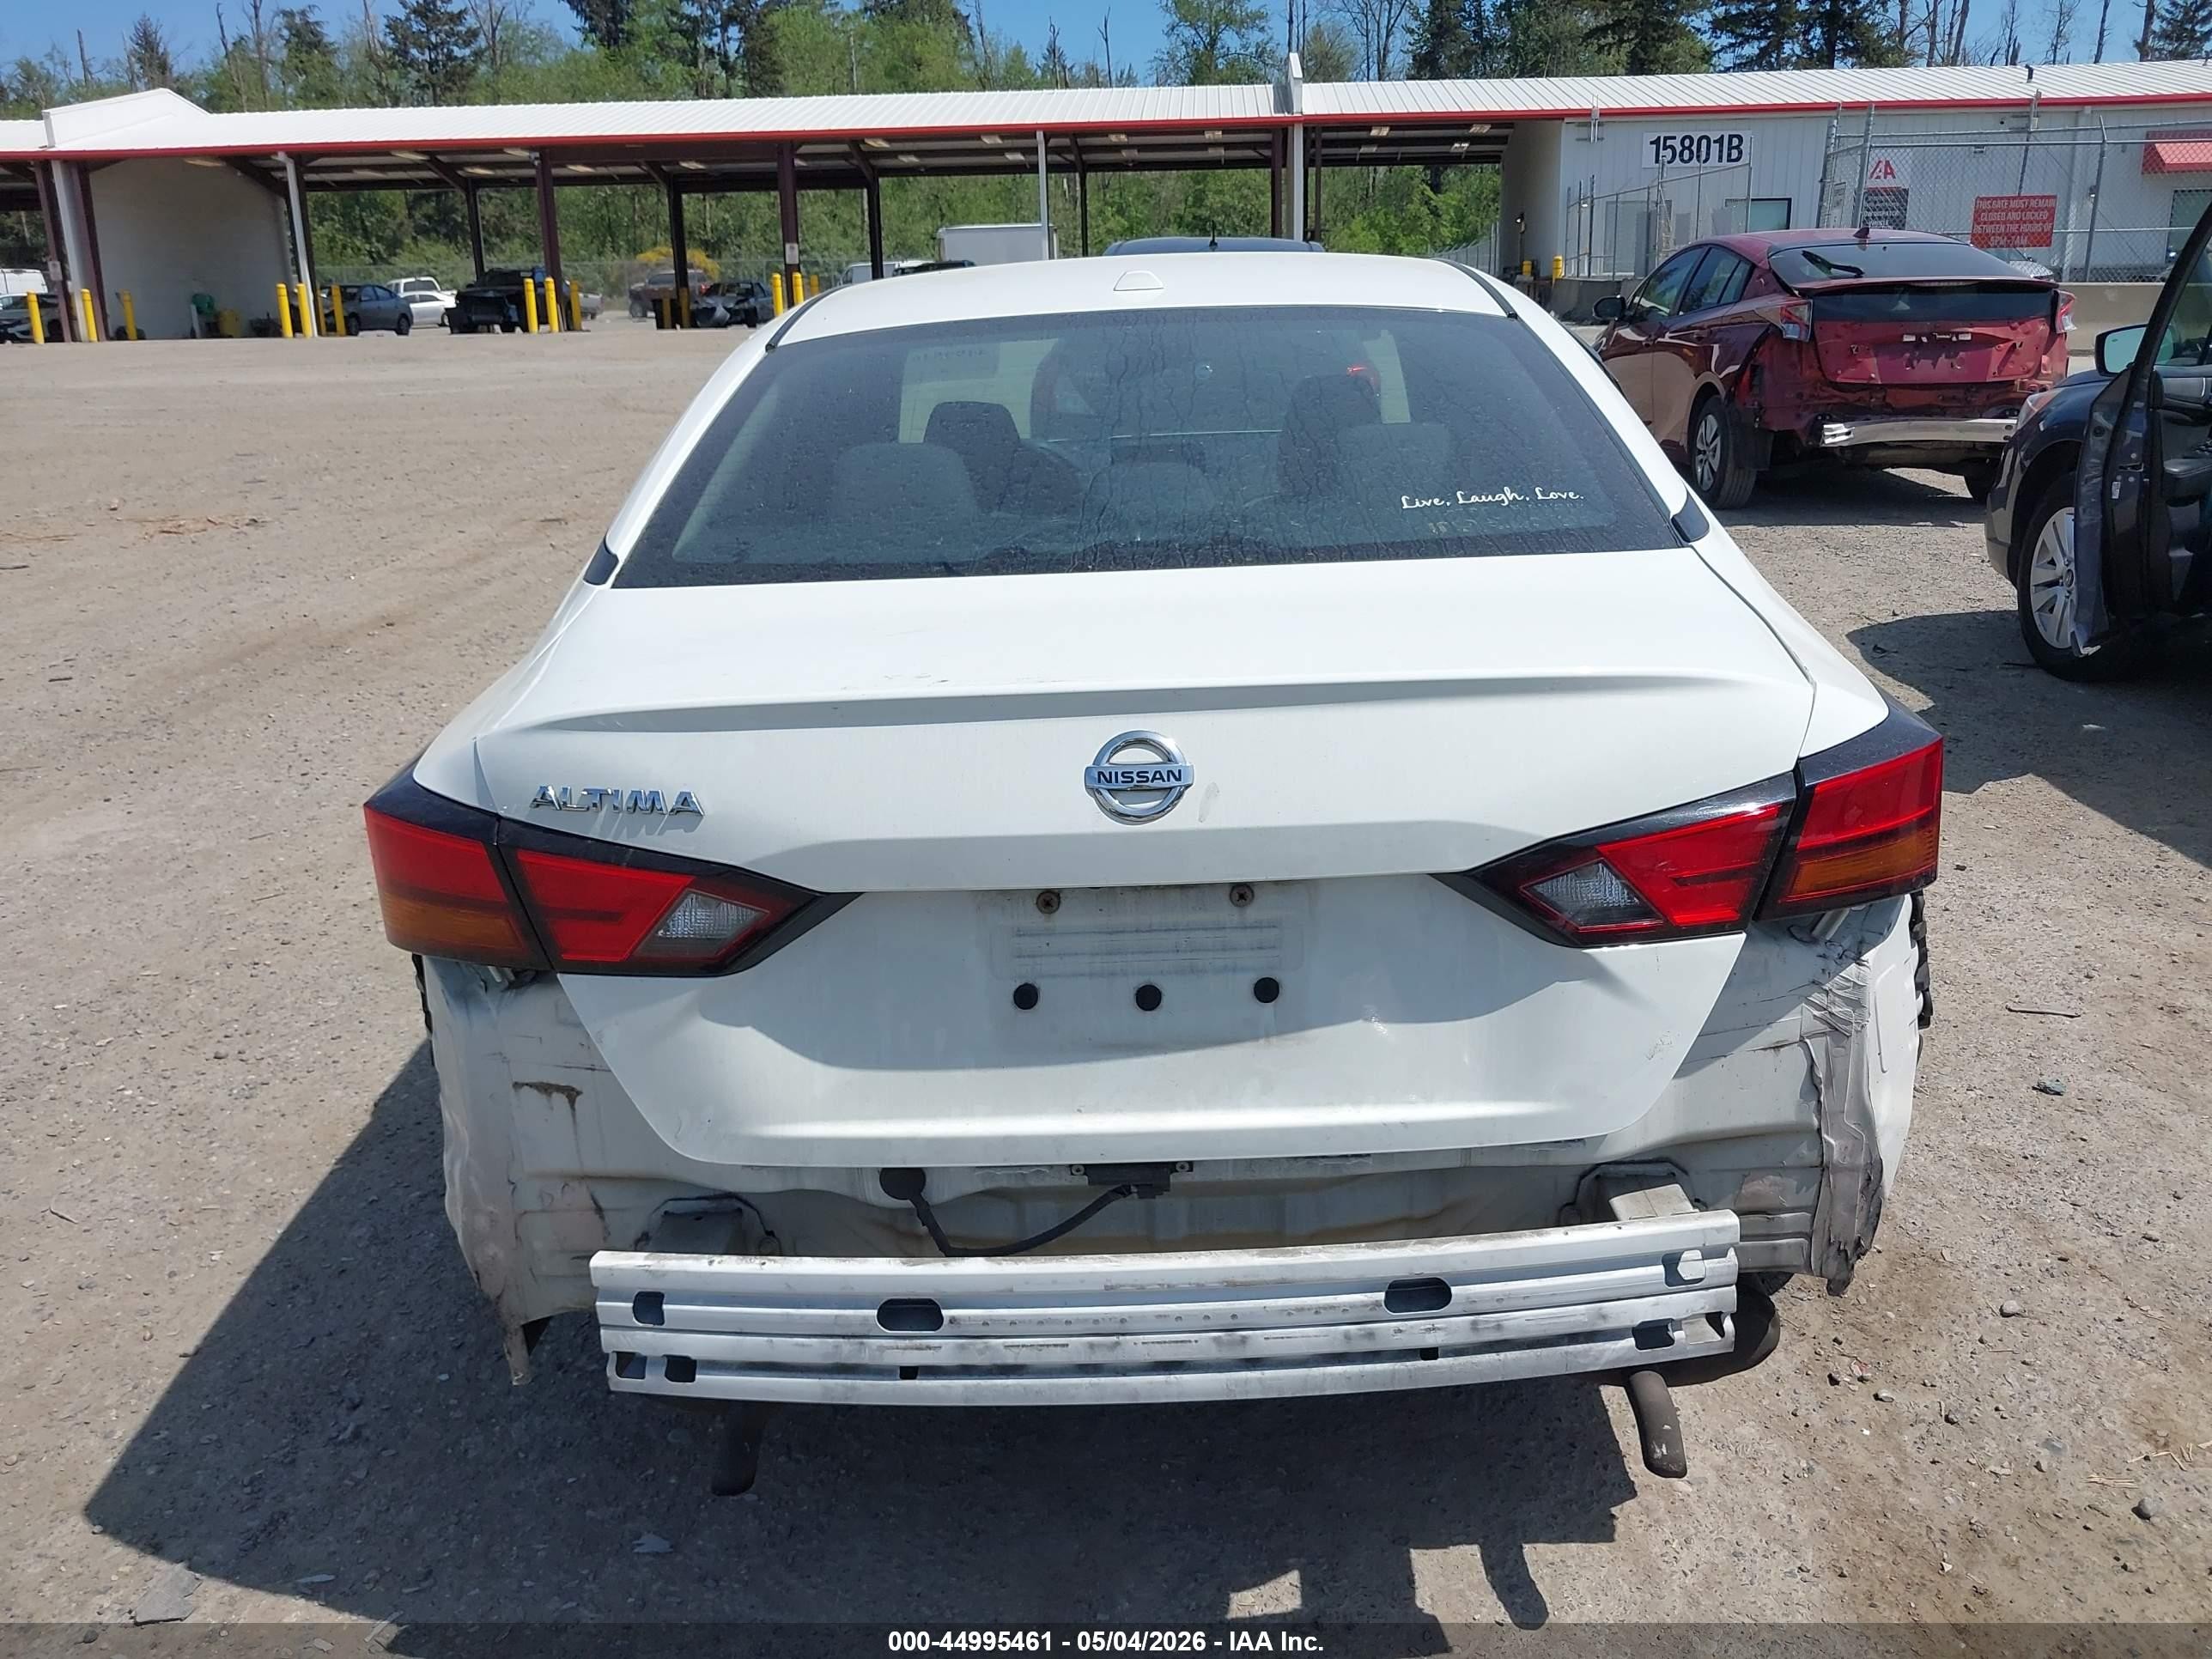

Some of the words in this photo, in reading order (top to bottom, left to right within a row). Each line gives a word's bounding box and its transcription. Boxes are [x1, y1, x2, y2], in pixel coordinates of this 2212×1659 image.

[1649, 134, 1744, 164] 15801B
[1977, 199, 1991, 209] THIS
[1991, 199, 2009, 209] GATE
[2009, 199, 2029, 209] MUST
[2029, 198, 2057, 208] REMAIN
[1980, 211, 2006, 221] CLOSED
[2007, 211, 2021, 221] AND
[2022, 210, 2049, 220] LOCKED
[1973, 224, 2006, 234] BETWEEN
[2006, 224, 2020, 233] THE
[2020, 223, 2043, 233] HOURS
[2044, 223, 2053, 232] OF
[1401, 495, 1451, 509] Live.
[1456, 486, 1530, 507] Laugh.
[1534, 486, 1585, 500] Love.
[1097, 769, 1182, 784] NISSAN
[529, 785, 706, 817] ALTIMA
